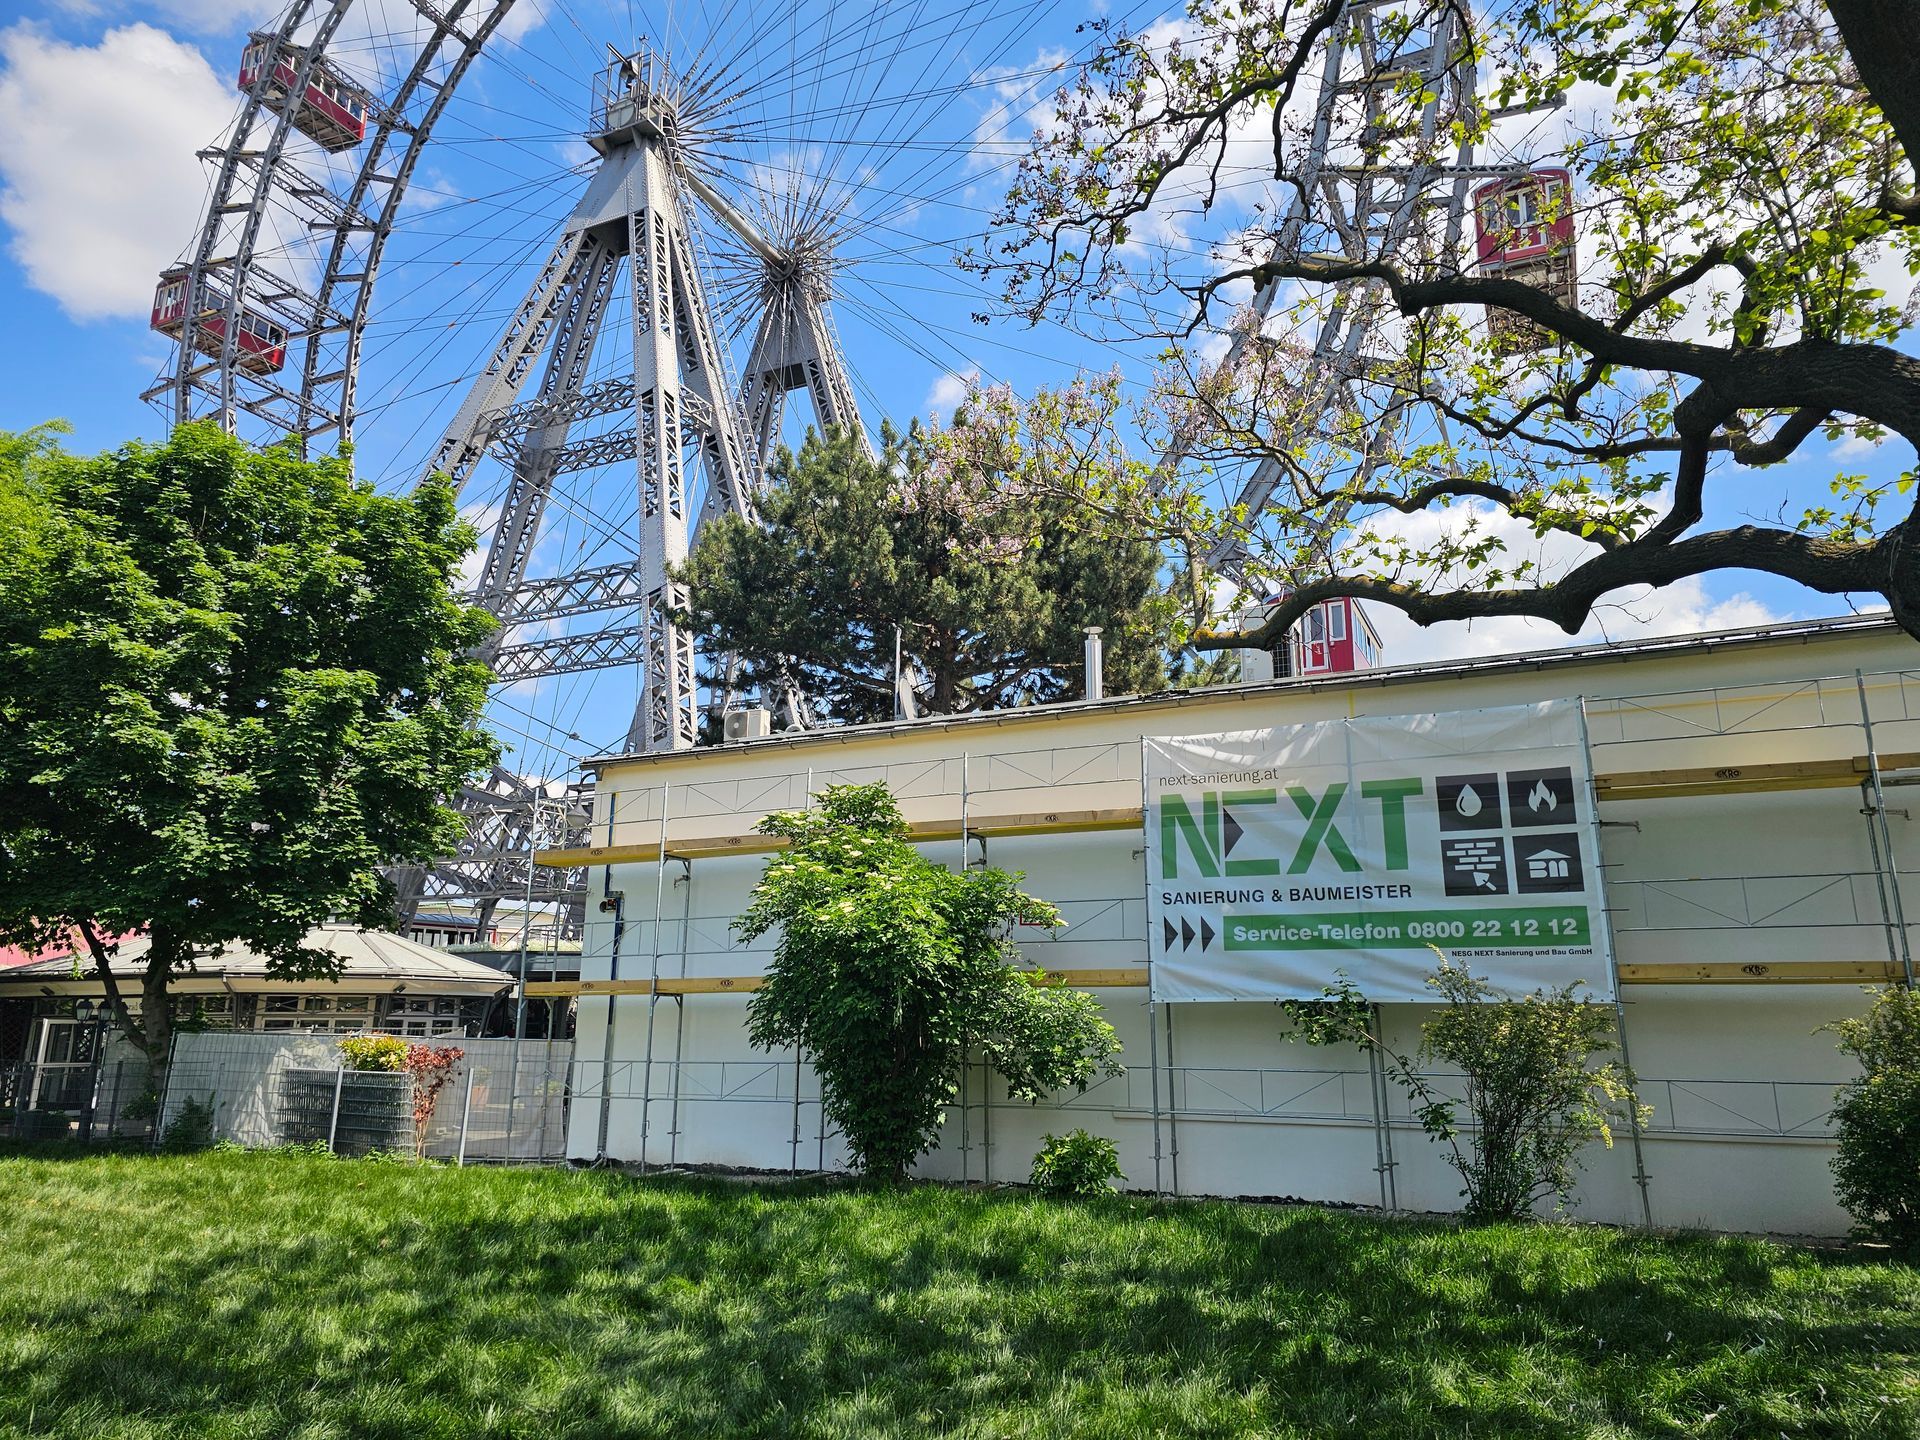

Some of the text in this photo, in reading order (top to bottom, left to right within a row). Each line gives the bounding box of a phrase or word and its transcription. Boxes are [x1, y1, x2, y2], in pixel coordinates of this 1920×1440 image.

[1159, 768, 1279, 786] next-sanierung.at
[1160, 777, 1424, 880] NEXT
[1162, 884, 1412, 906] SANIERUNG & BAUMEISTER
[1233, 917, 1578, 942] Service-Telefon 0800 22 12 12
[1495, 949, 1534, 958] Sanierung
[1568, 948, 1593, 956] GmbH
